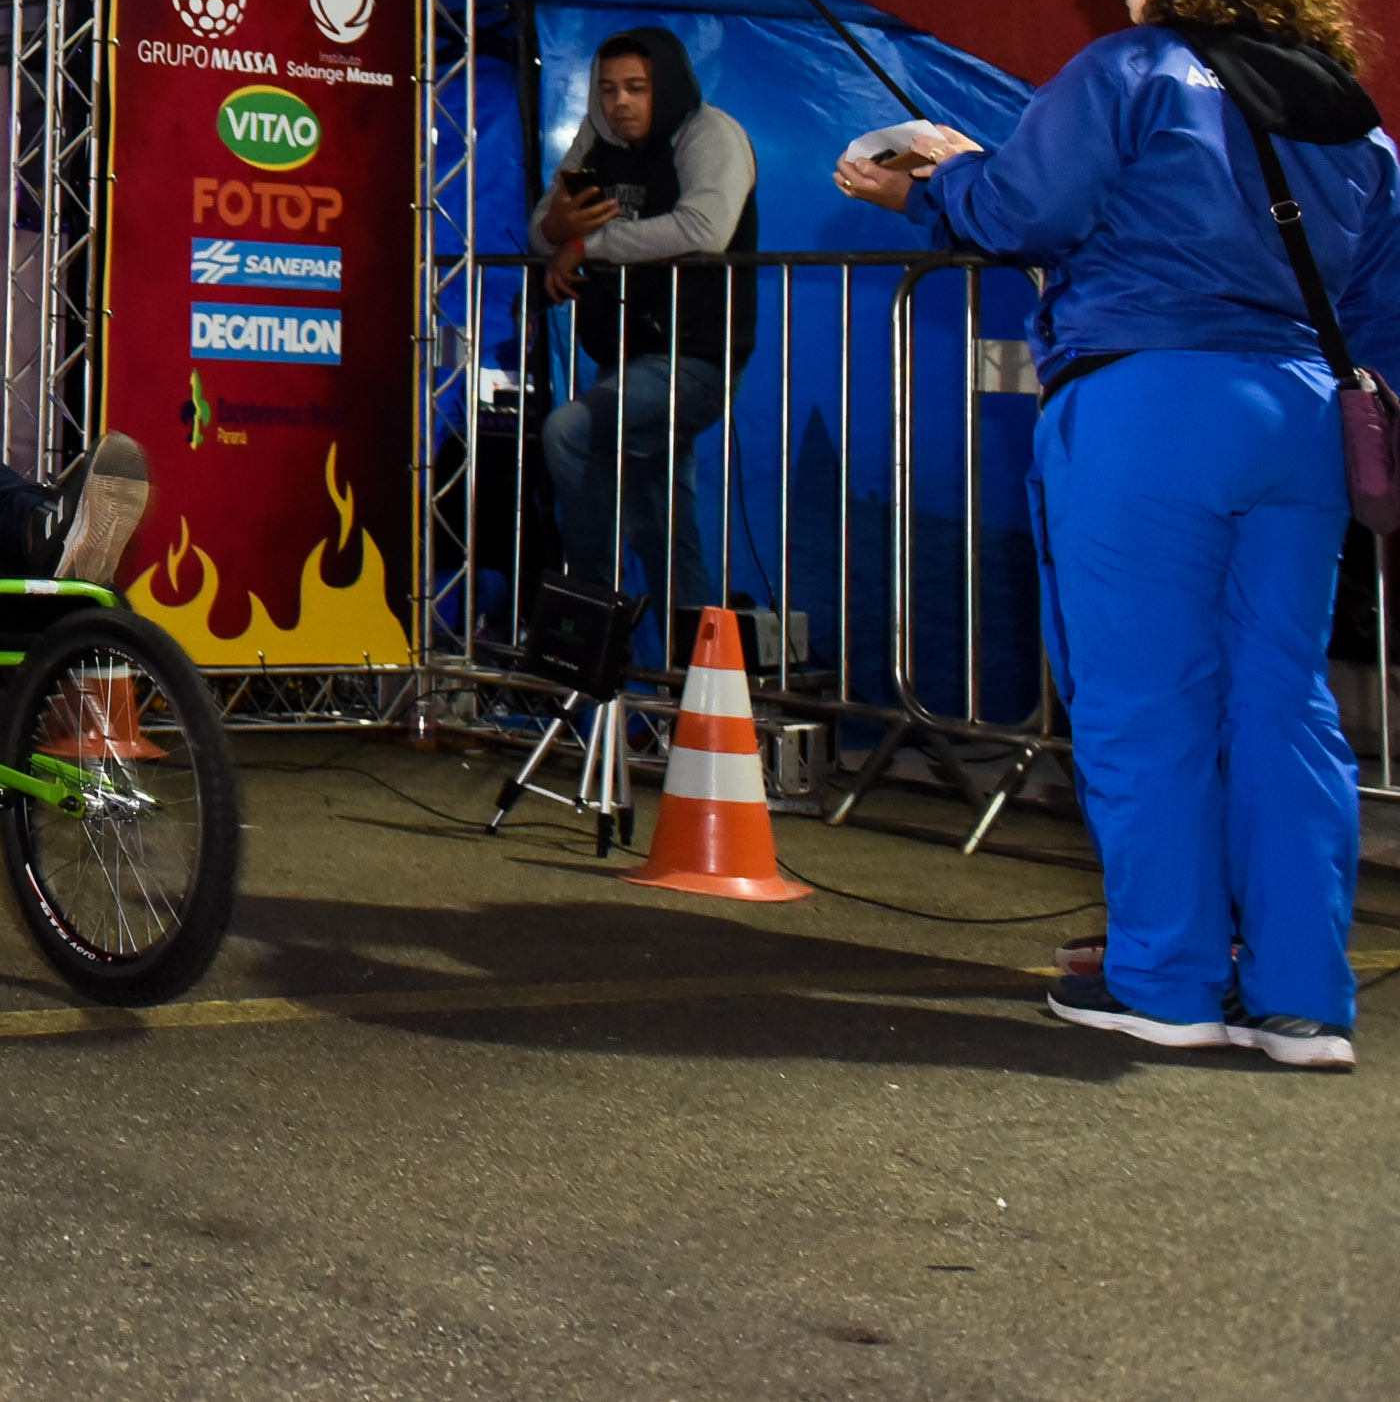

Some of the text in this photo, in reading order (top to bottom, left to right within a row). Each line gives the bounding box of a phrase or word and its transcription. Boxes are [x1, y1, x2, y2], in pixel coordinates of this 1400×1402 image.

[137, 39, 277, 75] GRUPO MASSA
[286, 60, 394, 87] Solange Massa
[225, 106, 318, 148] VITAO
[192, 177, 343, 233] FOTOP
[244, 254, 342, 278] SANEPAR
[191, 313, 341, 356] DECATHLON
